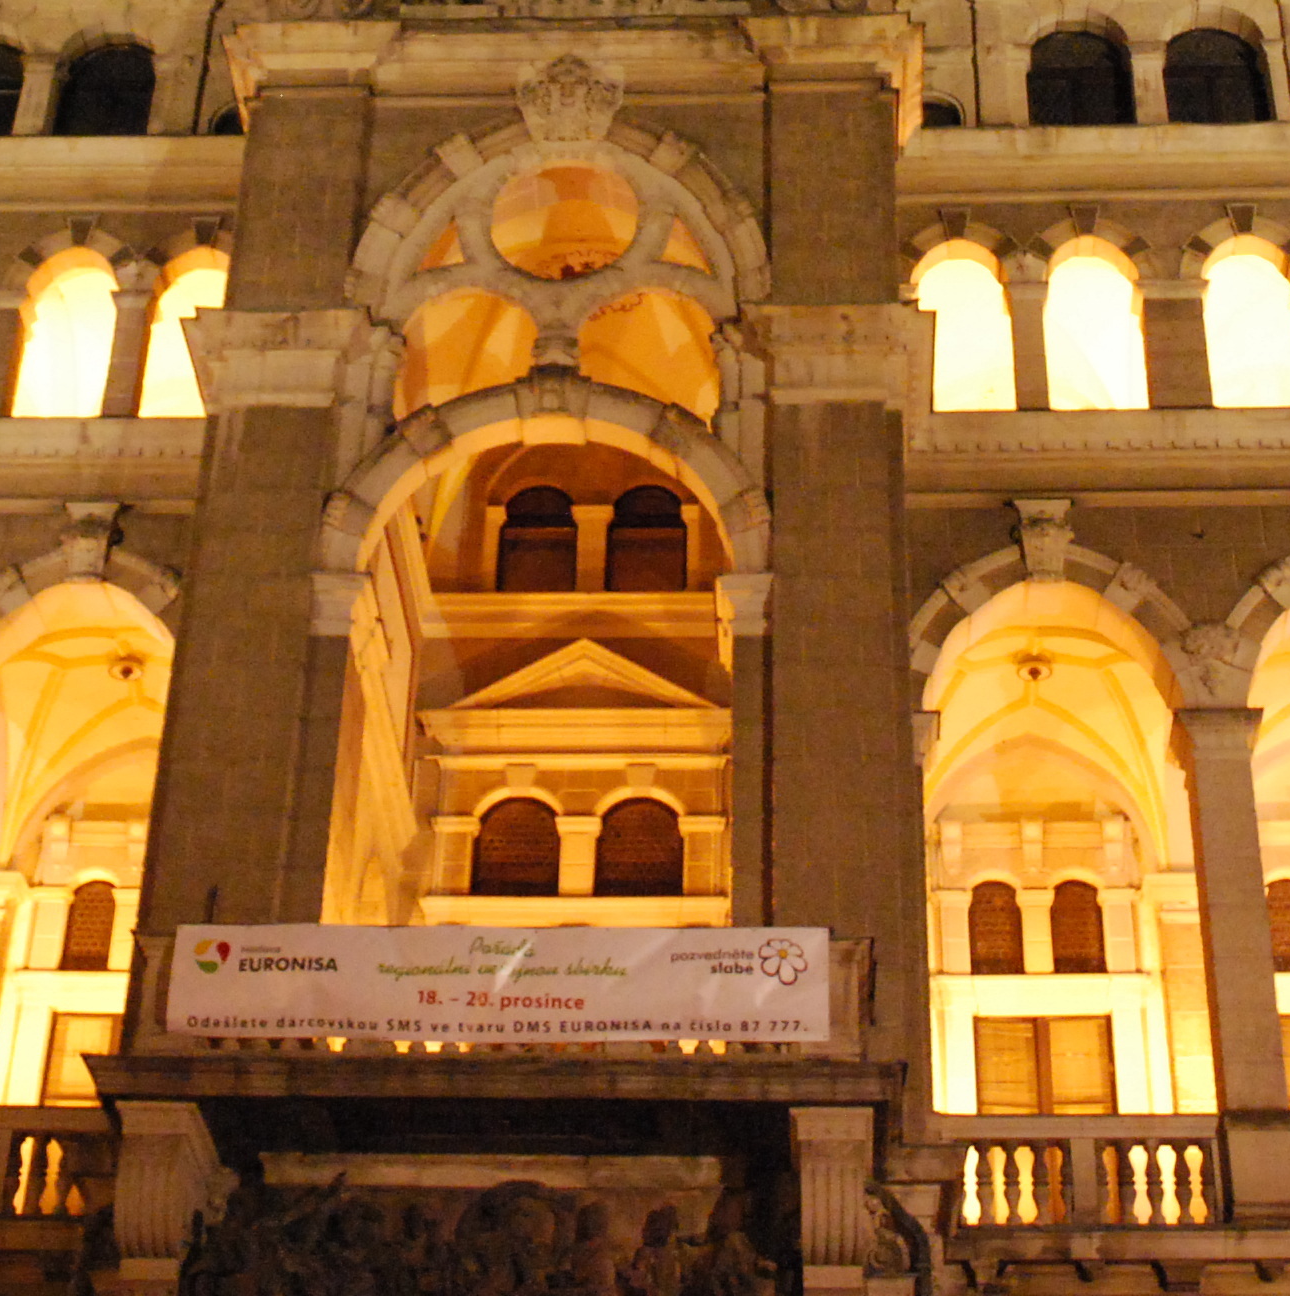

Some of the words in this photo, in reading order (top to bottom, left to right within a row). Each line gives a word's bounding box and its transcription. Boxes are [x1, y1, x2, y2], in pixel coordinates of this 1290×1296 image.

[670, 948, 754, 963] pozvedněte
[238, 957, 338, 972] EURONISA
[417, 990, 443, 1005] 18.
[466, 991, 494, 1006] 20.
[500, 993, 585, 1011] prosince
[386, 1019, 422, 1032] SMS
[430, 1021, 450, 1033] ve
[458, 1020, 505, 1033] tvaru
[513, 1020, 551, 1033] DMS
[559, 1020, 652, 1033] EURONISA
[661, 1021, 681, 1031] na
[740, 1020, 760, 1032] 87
[769, 1020, 808, 1032] 777.
